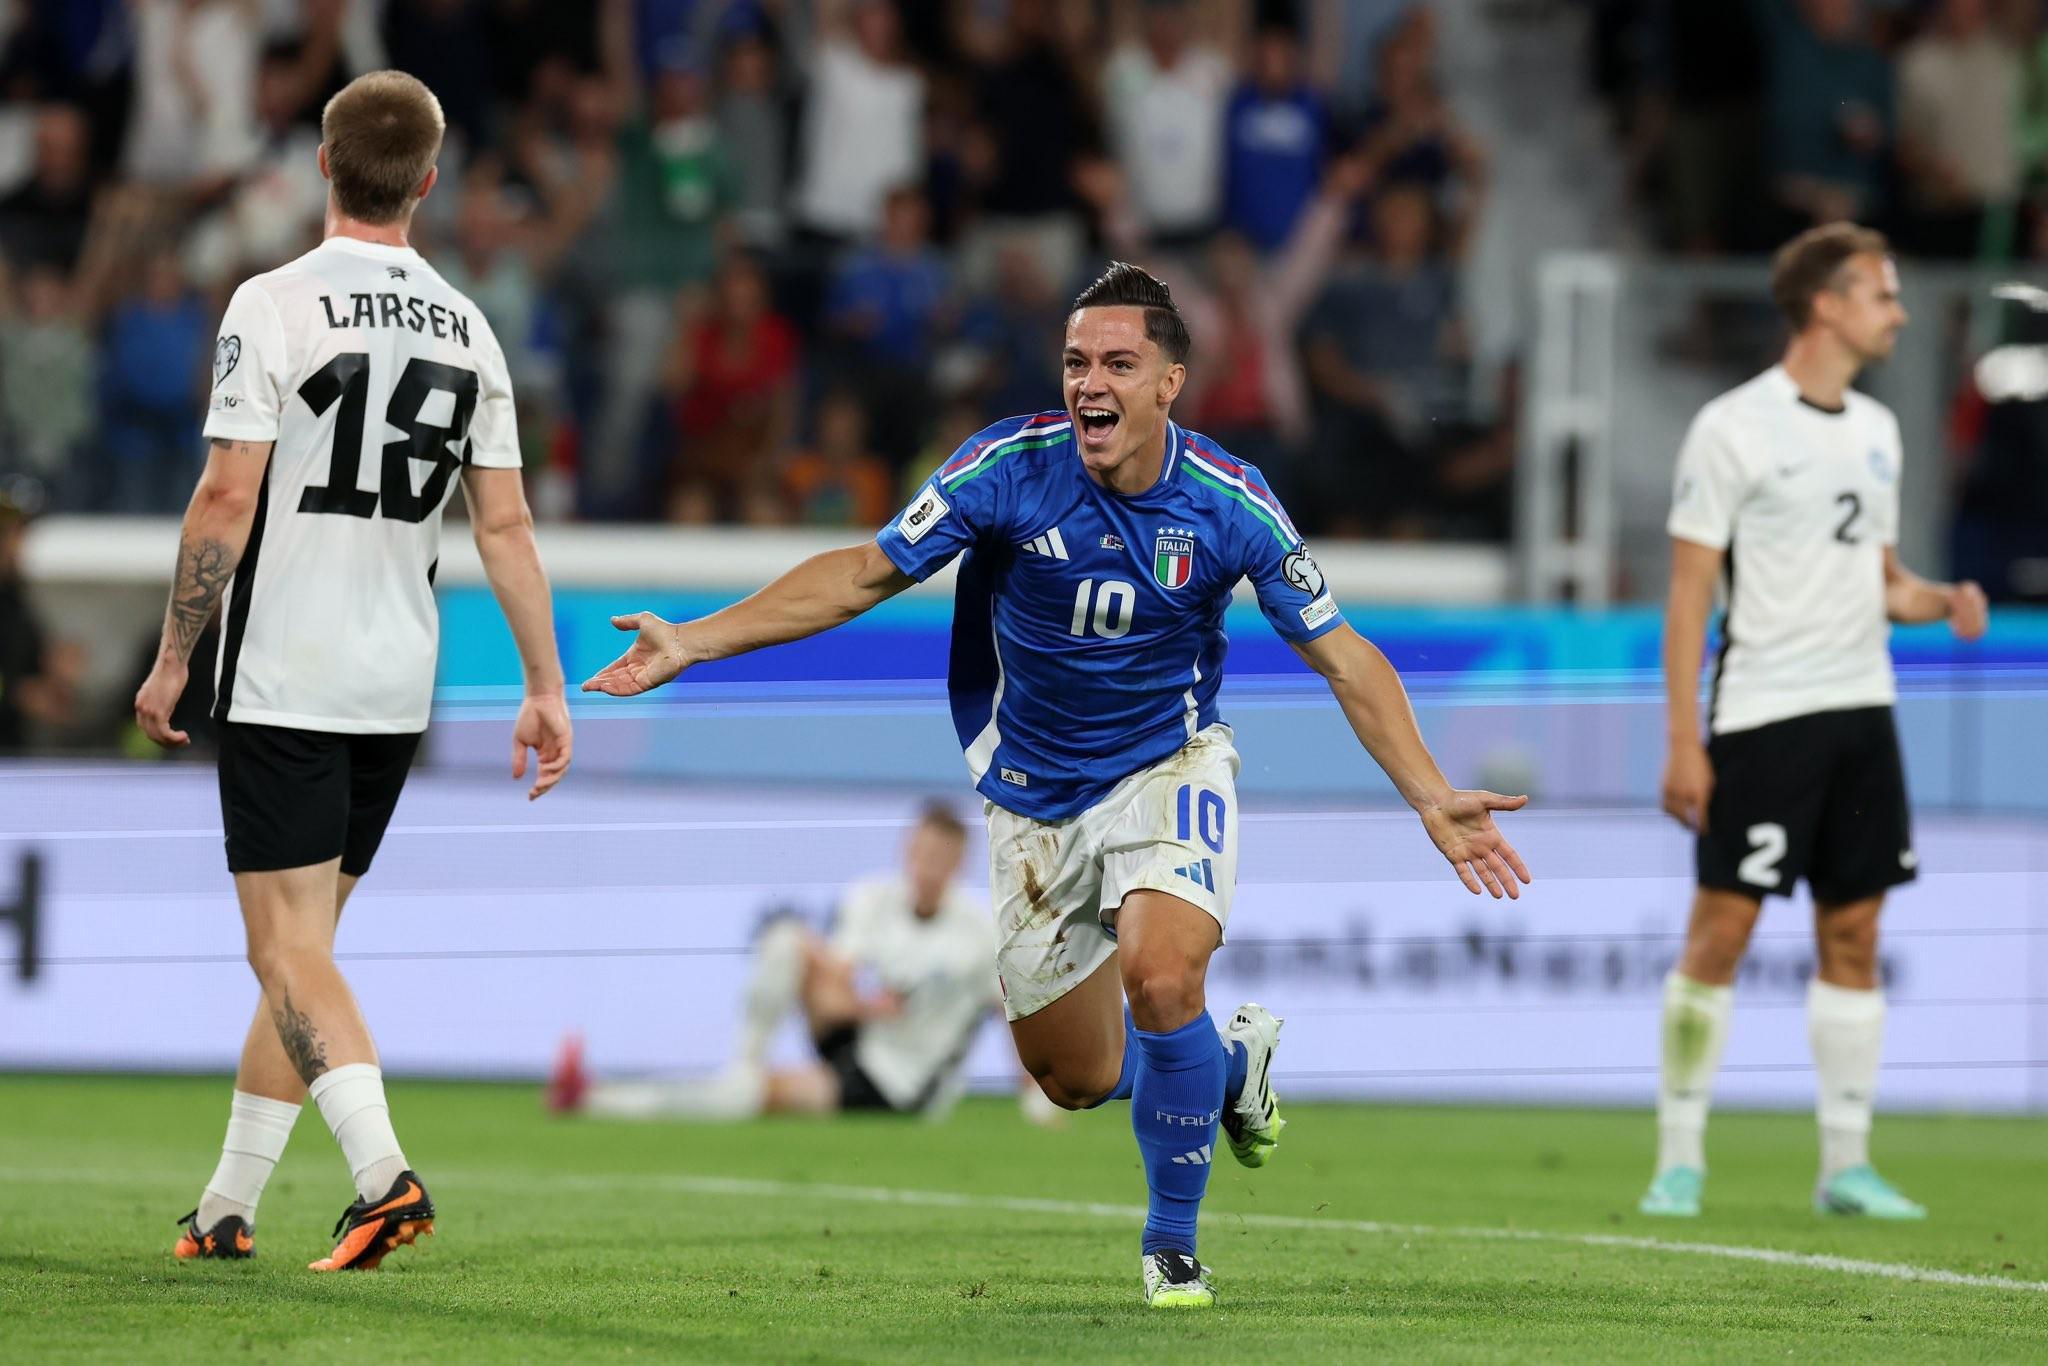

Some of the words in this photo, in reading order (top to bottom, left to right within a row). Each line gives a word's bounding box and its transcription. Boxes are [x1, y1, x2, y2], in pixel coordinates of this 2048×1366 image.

[319, 292, 470, 348] LARSEN
[297, 352, 479, 524] 18
[1159, 540, 1190, 553] ITALIA
[1835, 490, 1862, 545] 2
[1070, 578, 1136, 639] 10
[1177, 784, 1226, 855] 10
[1737, 822, 1788, 889] 2
